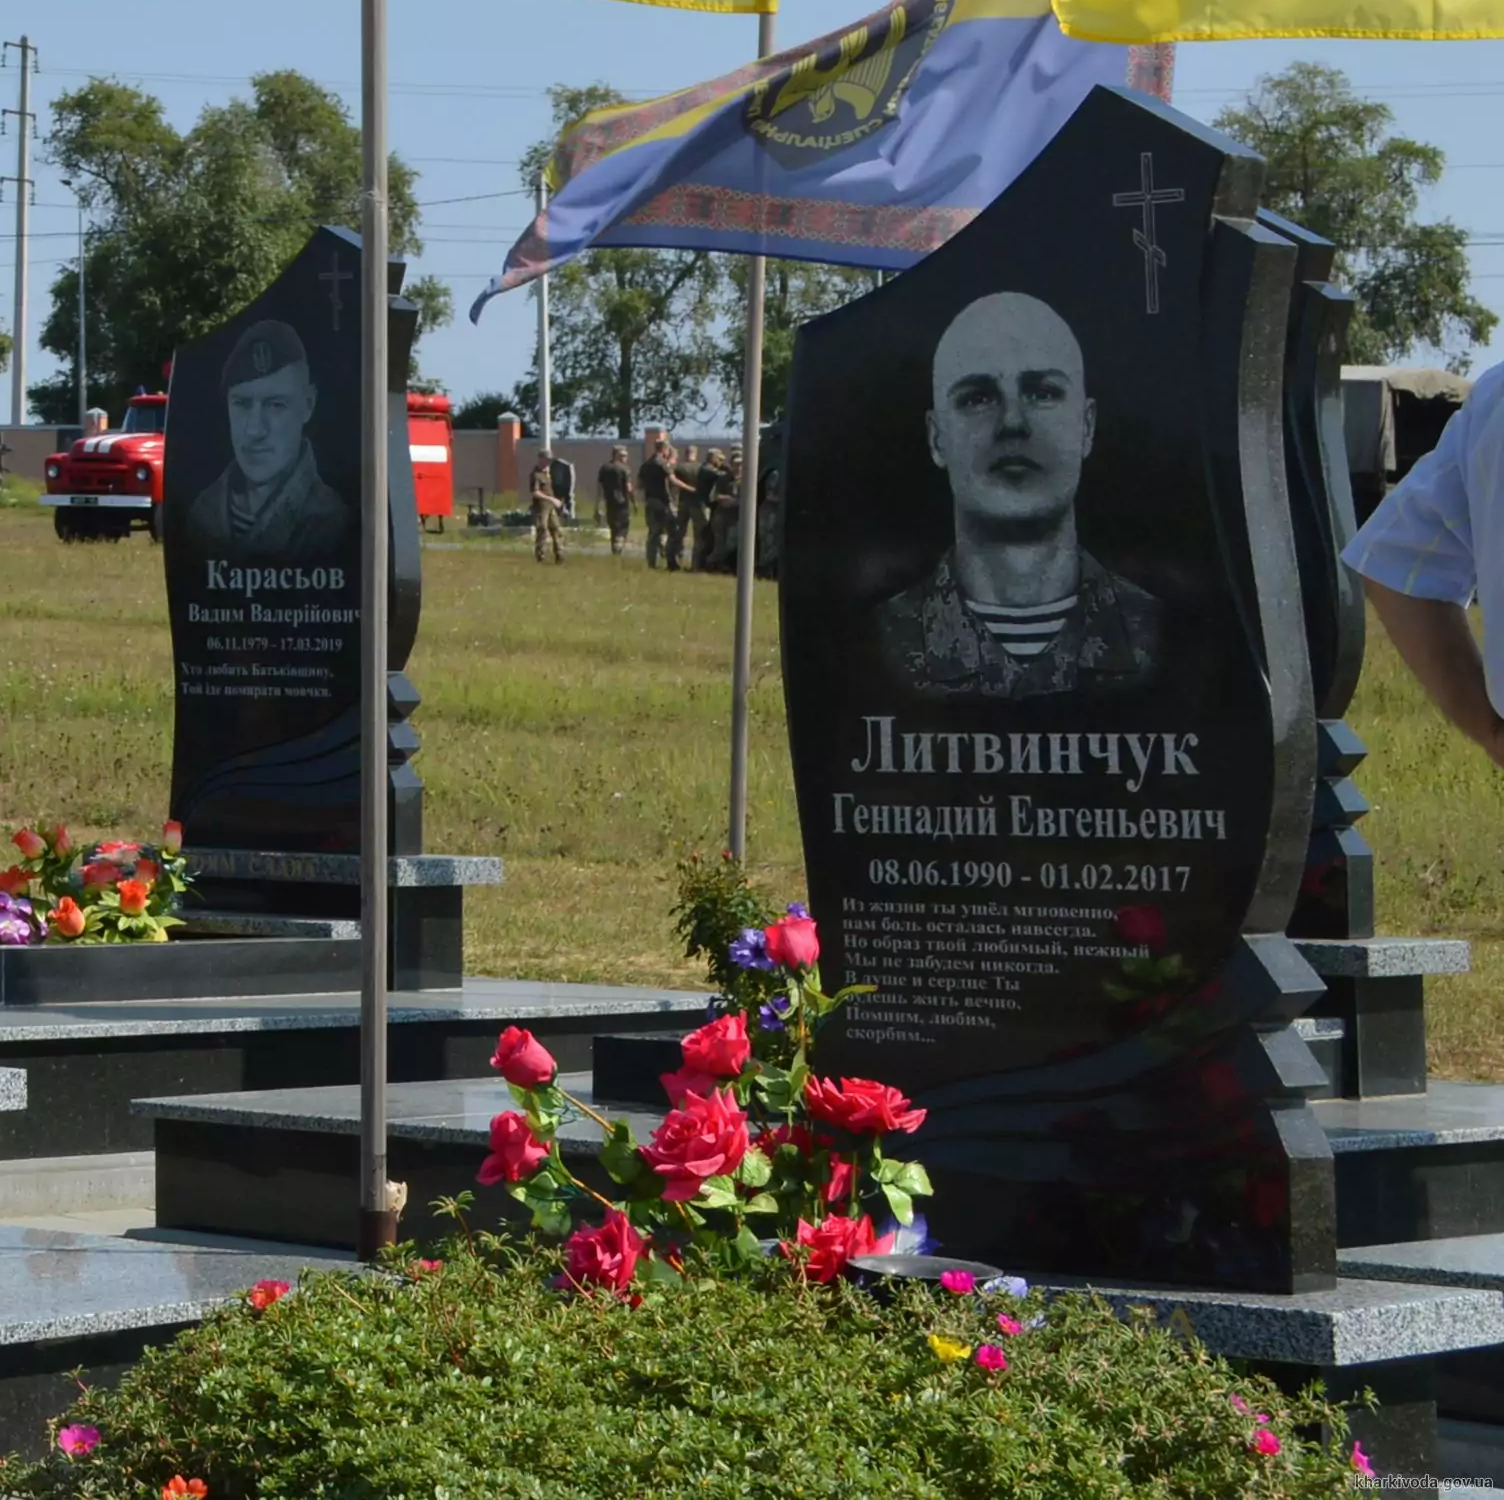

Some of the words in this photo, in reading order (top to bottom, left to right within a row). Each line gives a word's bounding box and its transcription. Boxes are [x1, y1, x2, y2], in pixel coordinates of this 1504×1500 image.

[206, 559, 346, 598] Карасьов
[188, 603, 244, 624] Вадим
[206, 638, 269, 651] 06.11.1979
[280, 638, 343, 651] 17.03.2019
[182, 682, 203, 696] Той
[851, 715, 1200, 793] Литвинчук
[832, 793, 998, 842] Геннадий
[1008, 794, 1227, 840] Евгеньевич
[868, 858, 1012, 889] 08.06.1990
[1040, 862, 1192, 893] 01.02.2017
[841, 897, 865, 914] Из
[869, 899, 926, 915] жизни
[929, 901, 957, 916] ты
[960, 900, 1010, 920] ушёл
[1012, 904, 1120, 922] мгновенно,
[842, 916, 877, 931] нам
[881, 916, 922, 932] боль
[926, 920, 1007, 935] осталась
[1011, 923, 1098, 939] навсегда.
[843, 934, 869, 950] Но
[872, 935, 921, 953] образ
[926, 937, 967, 953] твой
[972, 939, 1069, 958] любимый,
[1073, 942, 1151, 960] нежный
[844, 952, 877, 968] Мы
[882, 955, 903, 968] не
[906, 954, 975, 973] забудем
[980, 959, 1061, 975] никогда.
[844, 969, 856, 984] В
[861, 972, 907, 989] душе
[911, 974, 923, 987] и
[927, 975, 988, 993] сердце
[994, 975, 1021, 991] Ты
[911, 992, 959, 1008] жить
[929, 1010, 997, 1030] любим,
[845, 1026, 936, 1045] скорбим...
